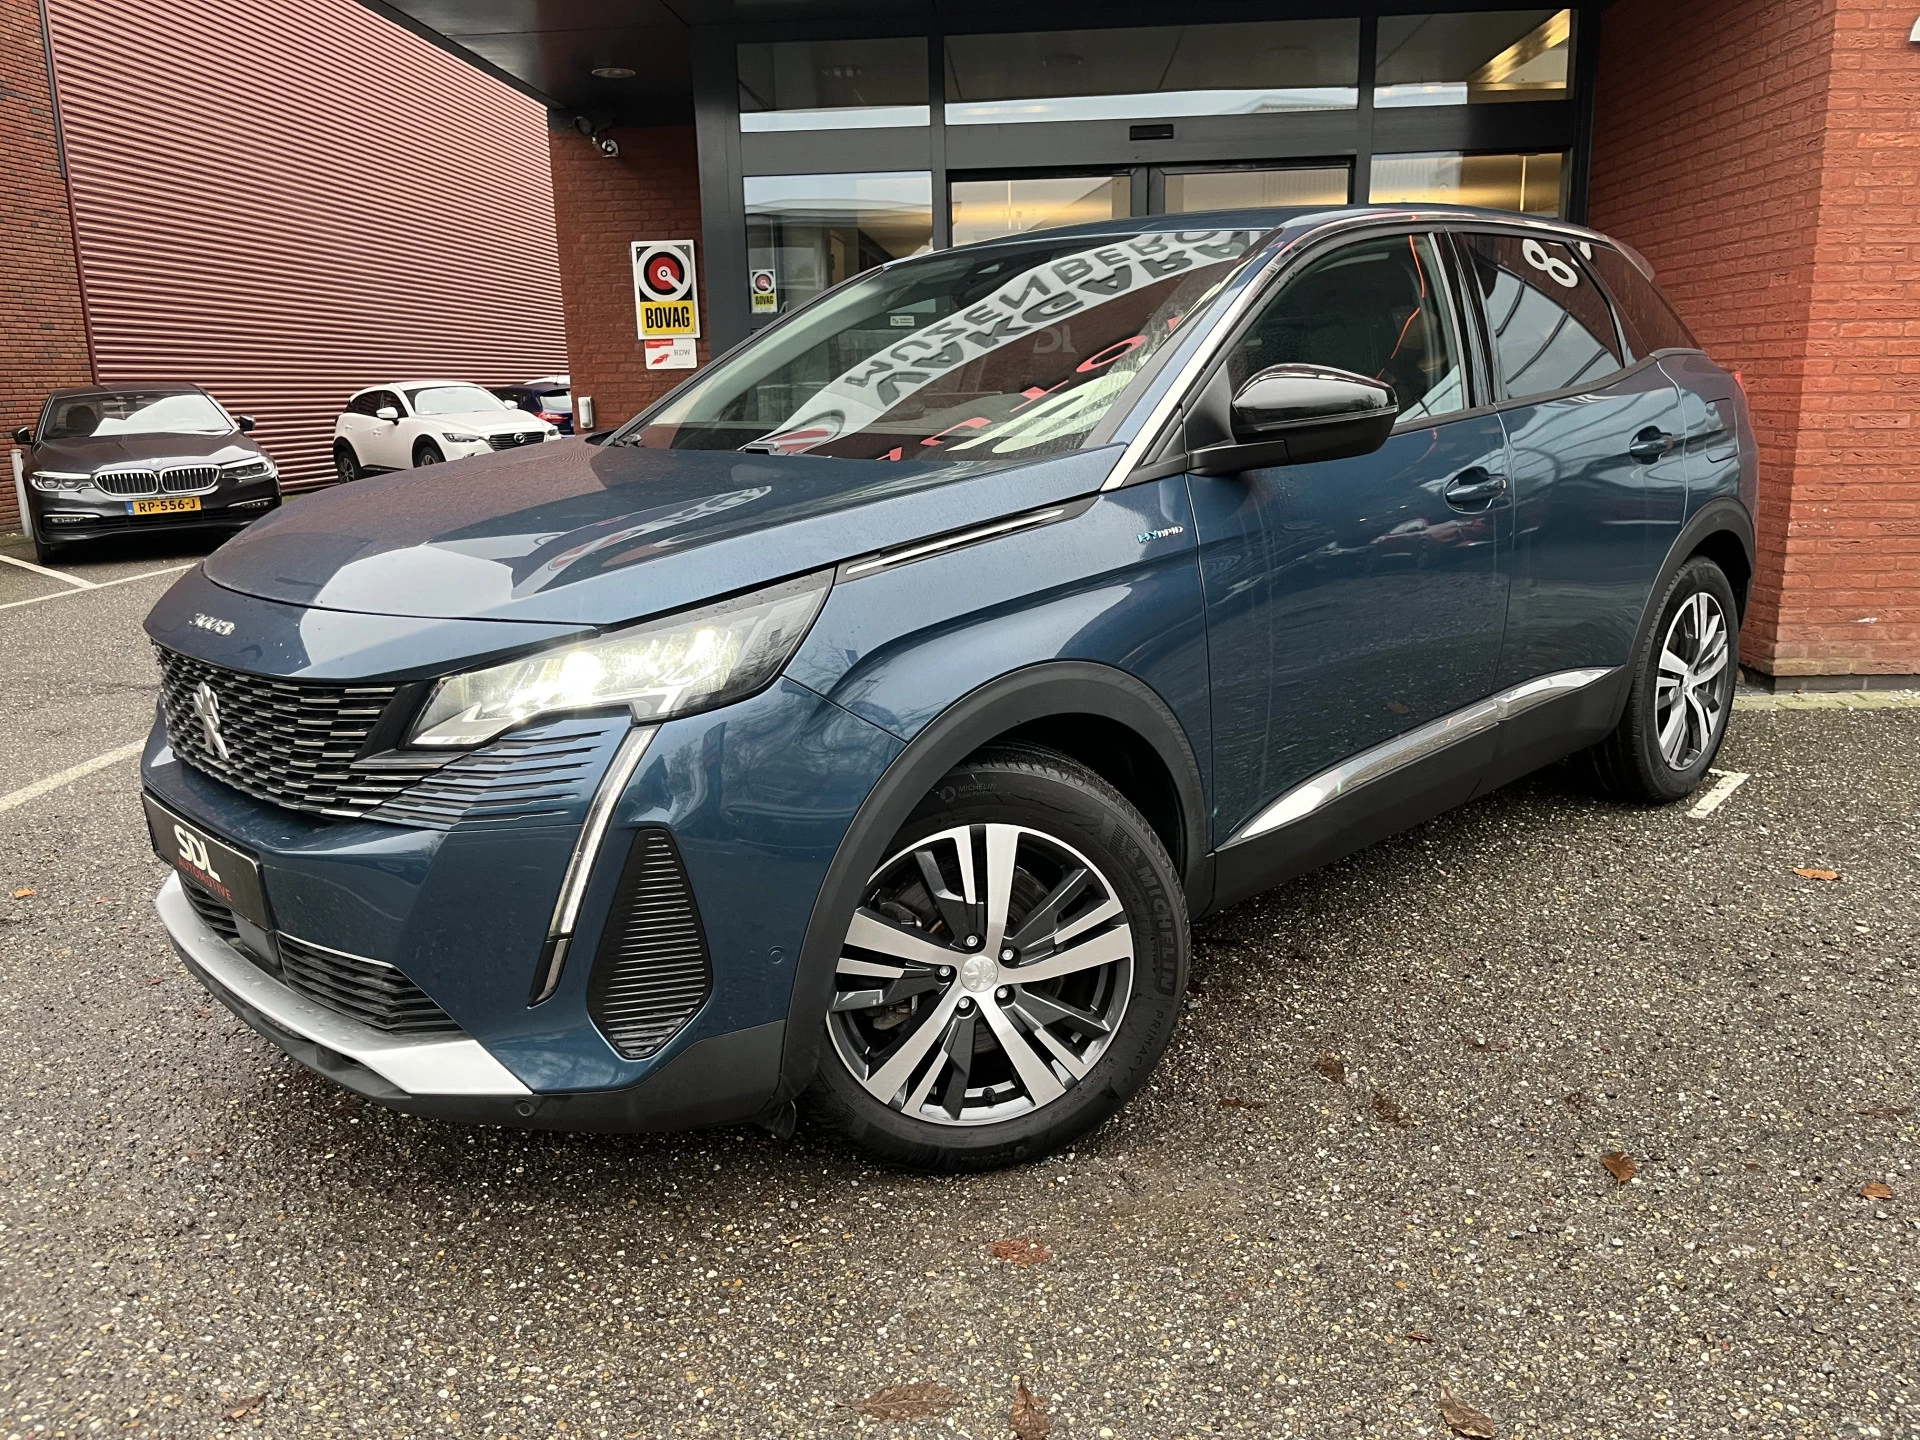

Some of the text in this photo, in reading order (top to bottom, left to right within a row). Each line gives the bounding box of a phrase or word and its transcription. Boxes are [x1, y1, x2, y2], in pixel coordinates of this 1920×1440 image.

[755, 295, 774, 305] BOVAG
[645, 306, 690, 329] BOVAG
[138, 498, 197, 513] RP-556-J
[958, 783, 997, 793] MICHELIN
[174, 824, 222, 883] SDL
[178, 856, 233, 902] AUTOMOTIVE
[1136, 866, 1176, 992] MICHELIN
[1128, 1009, 1164, 1076] PRIMACY
